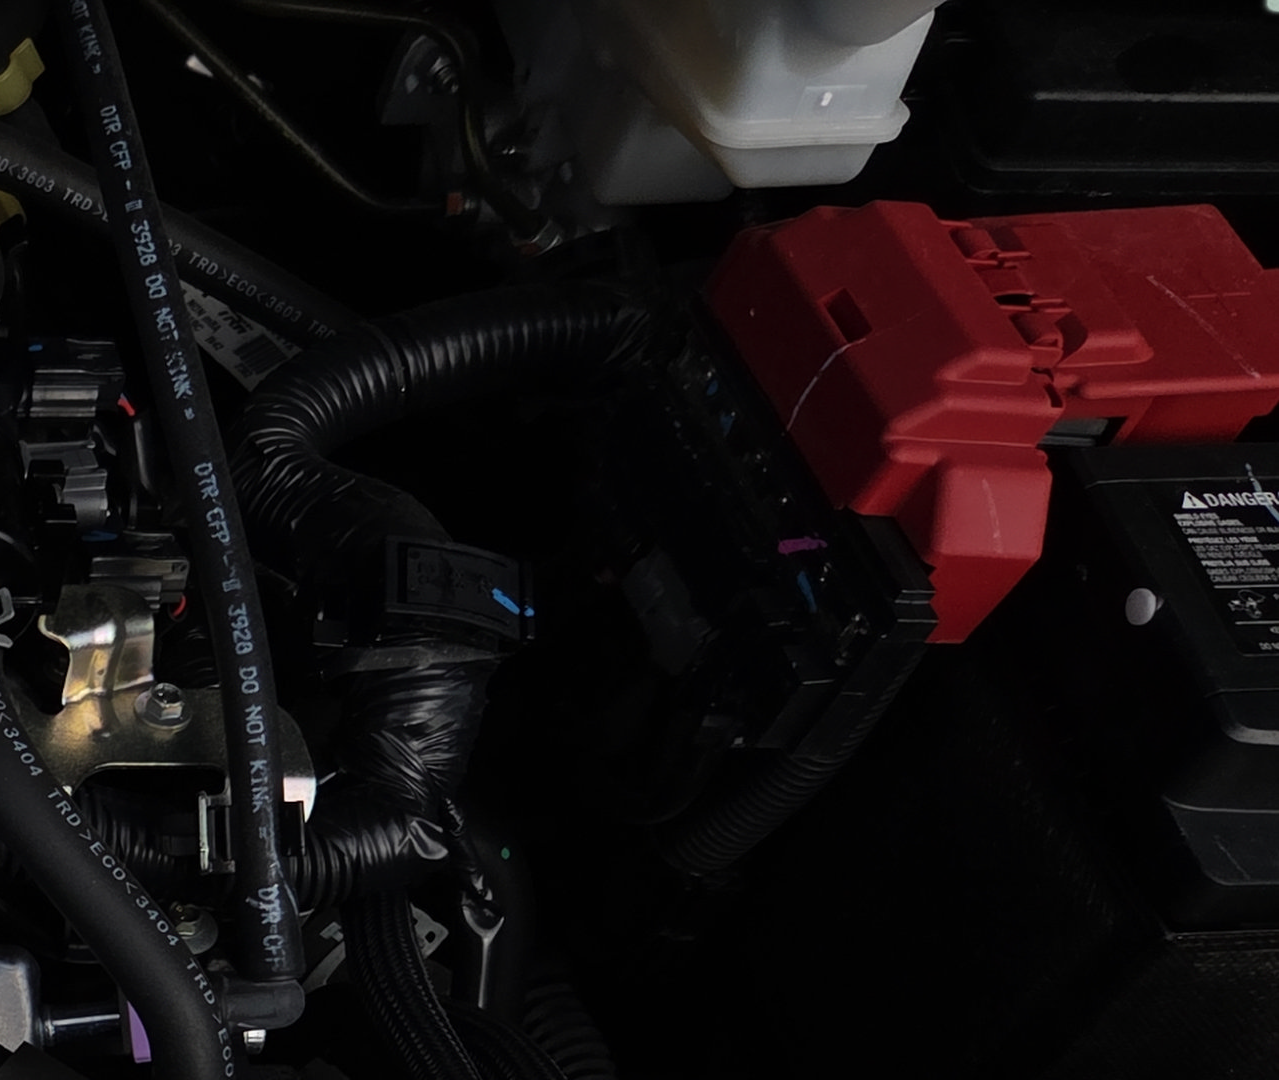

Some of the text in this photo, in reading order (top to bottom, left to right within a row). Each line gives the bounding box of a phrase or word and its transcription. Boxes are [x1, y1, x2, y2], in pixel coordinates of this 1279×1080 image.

[145, 273, 167, 300] DO
[153, 306, 179, 342] NOT
[194, 461, 219, 500] DTR
[206, 507, 231, 544] CFP
[239, 665, 260, 694] DO
[244, 705, 267, 746] NOT
